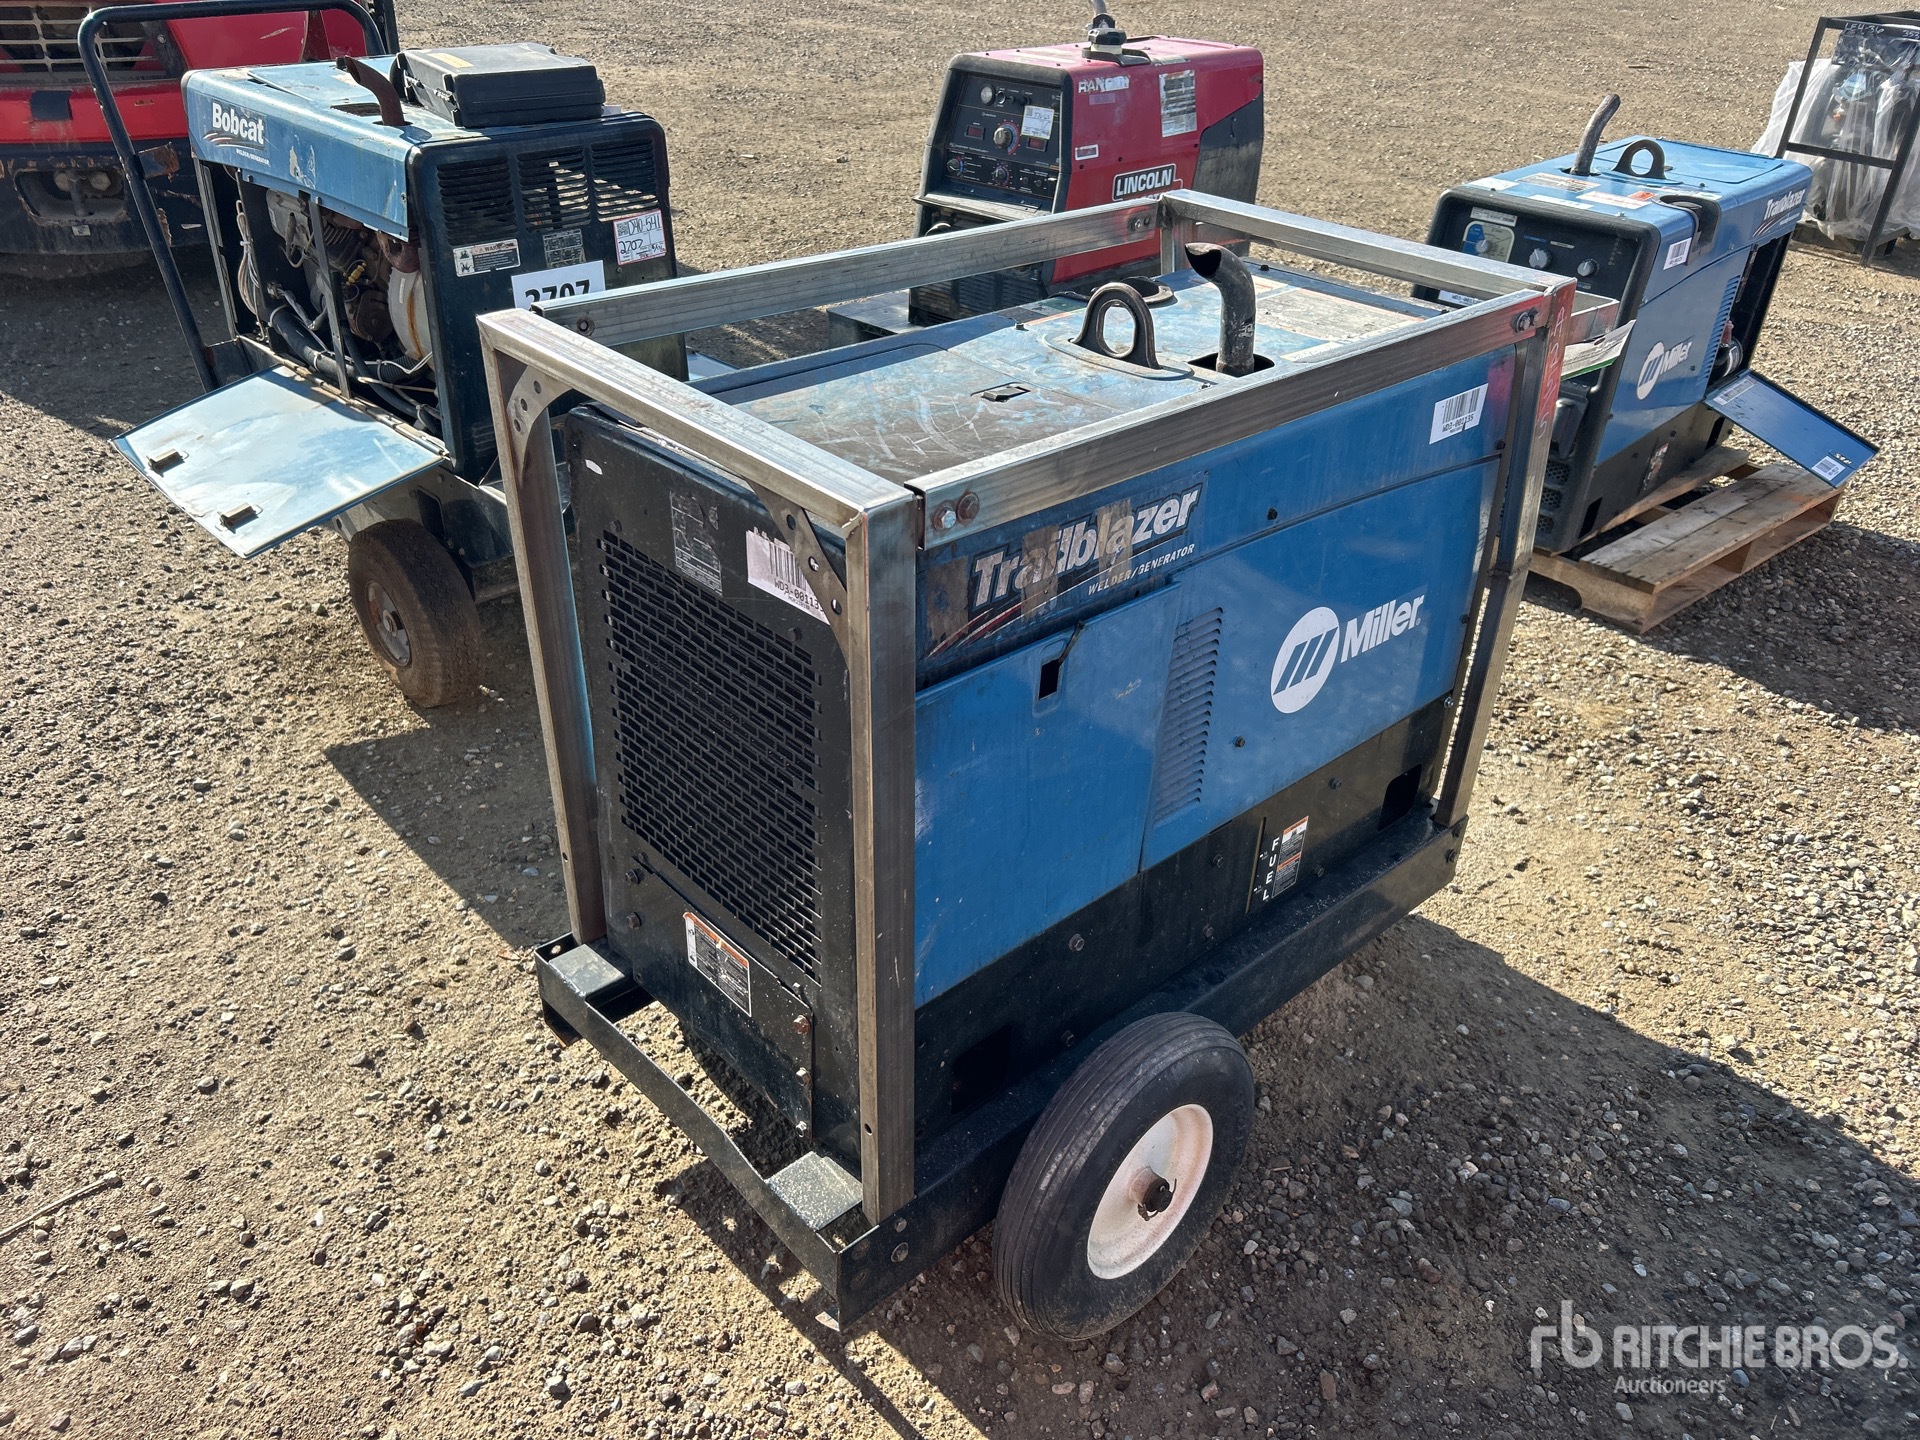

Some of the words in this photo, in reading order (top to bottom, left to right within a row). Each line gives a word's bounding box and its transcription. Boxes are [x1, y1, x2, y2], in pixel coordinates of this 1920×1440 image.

[212, 102, 264, 145] Bobcat
[1115, 168, 1172, 196] LINCOLN
[525, 279, 590, 311] 2707
[1660, 341, 1693, 375] Miller
[975, 489, 1200, 607] Trailblazer
[1088, 543, 1195, 596] WELDER/GENERATOR
[1340, 595, 1425, 664] Miller
[1262, 837, 1280, 901] FUEL
